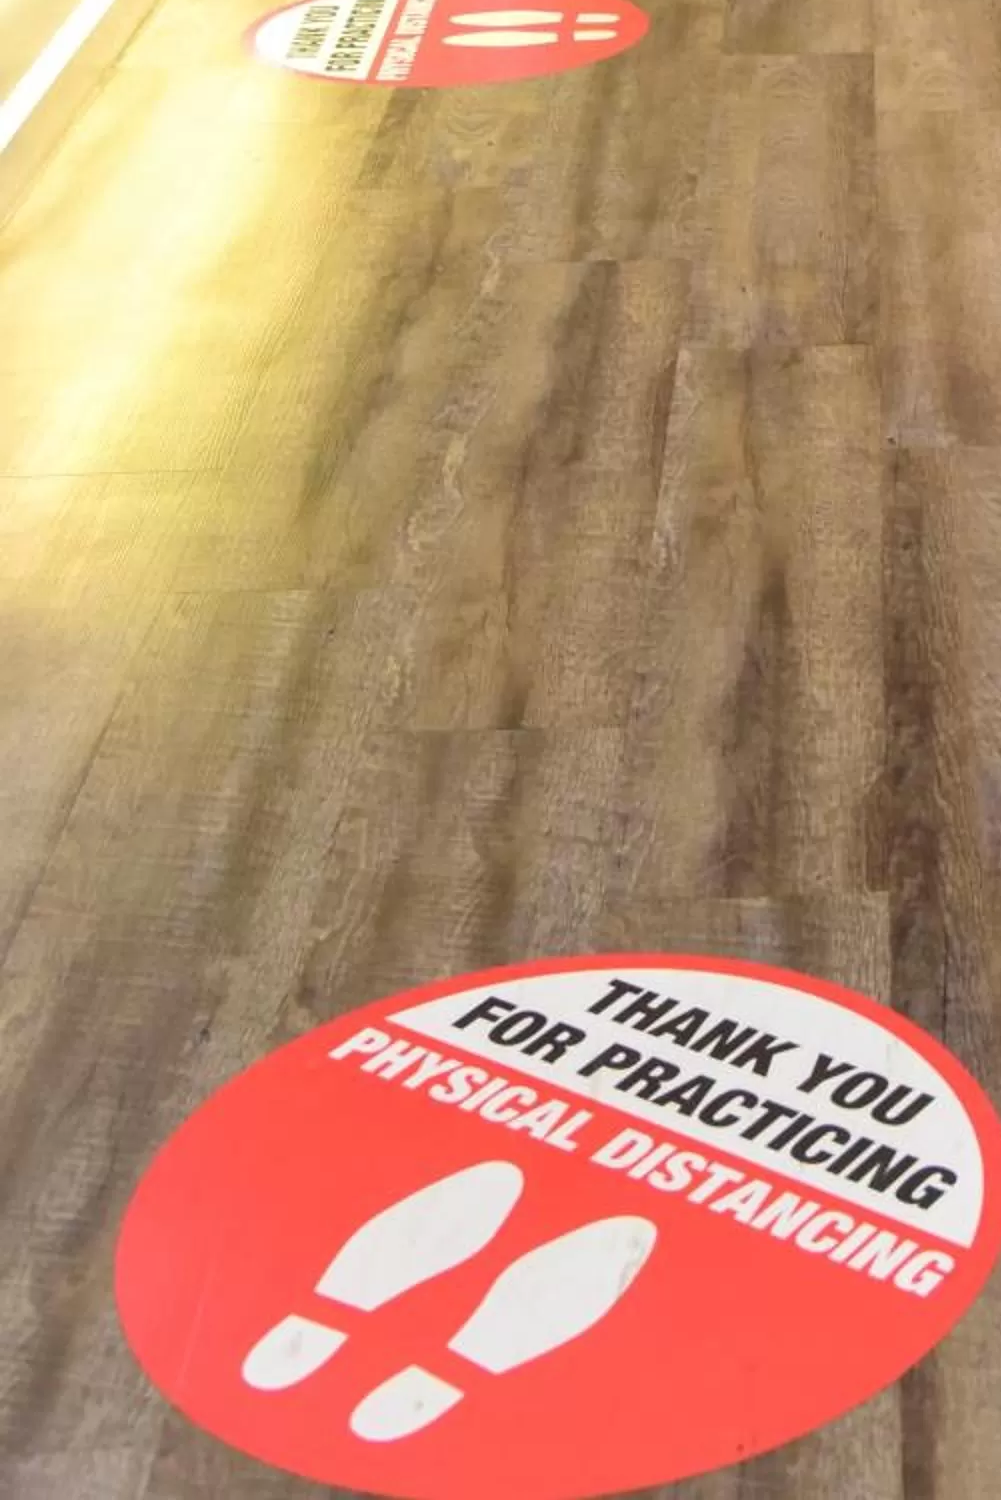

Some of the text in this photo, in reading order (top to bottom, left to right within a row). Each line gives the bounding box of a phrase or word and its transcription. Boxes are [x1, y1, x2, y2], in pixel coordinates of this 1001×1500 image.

[453, 995, 958, 1211] FOR PRACTICING
[586, 977, 936, 1128] THANK YOU
[328, 1026, 957, 1298] PHYSICAL DISTANCING
